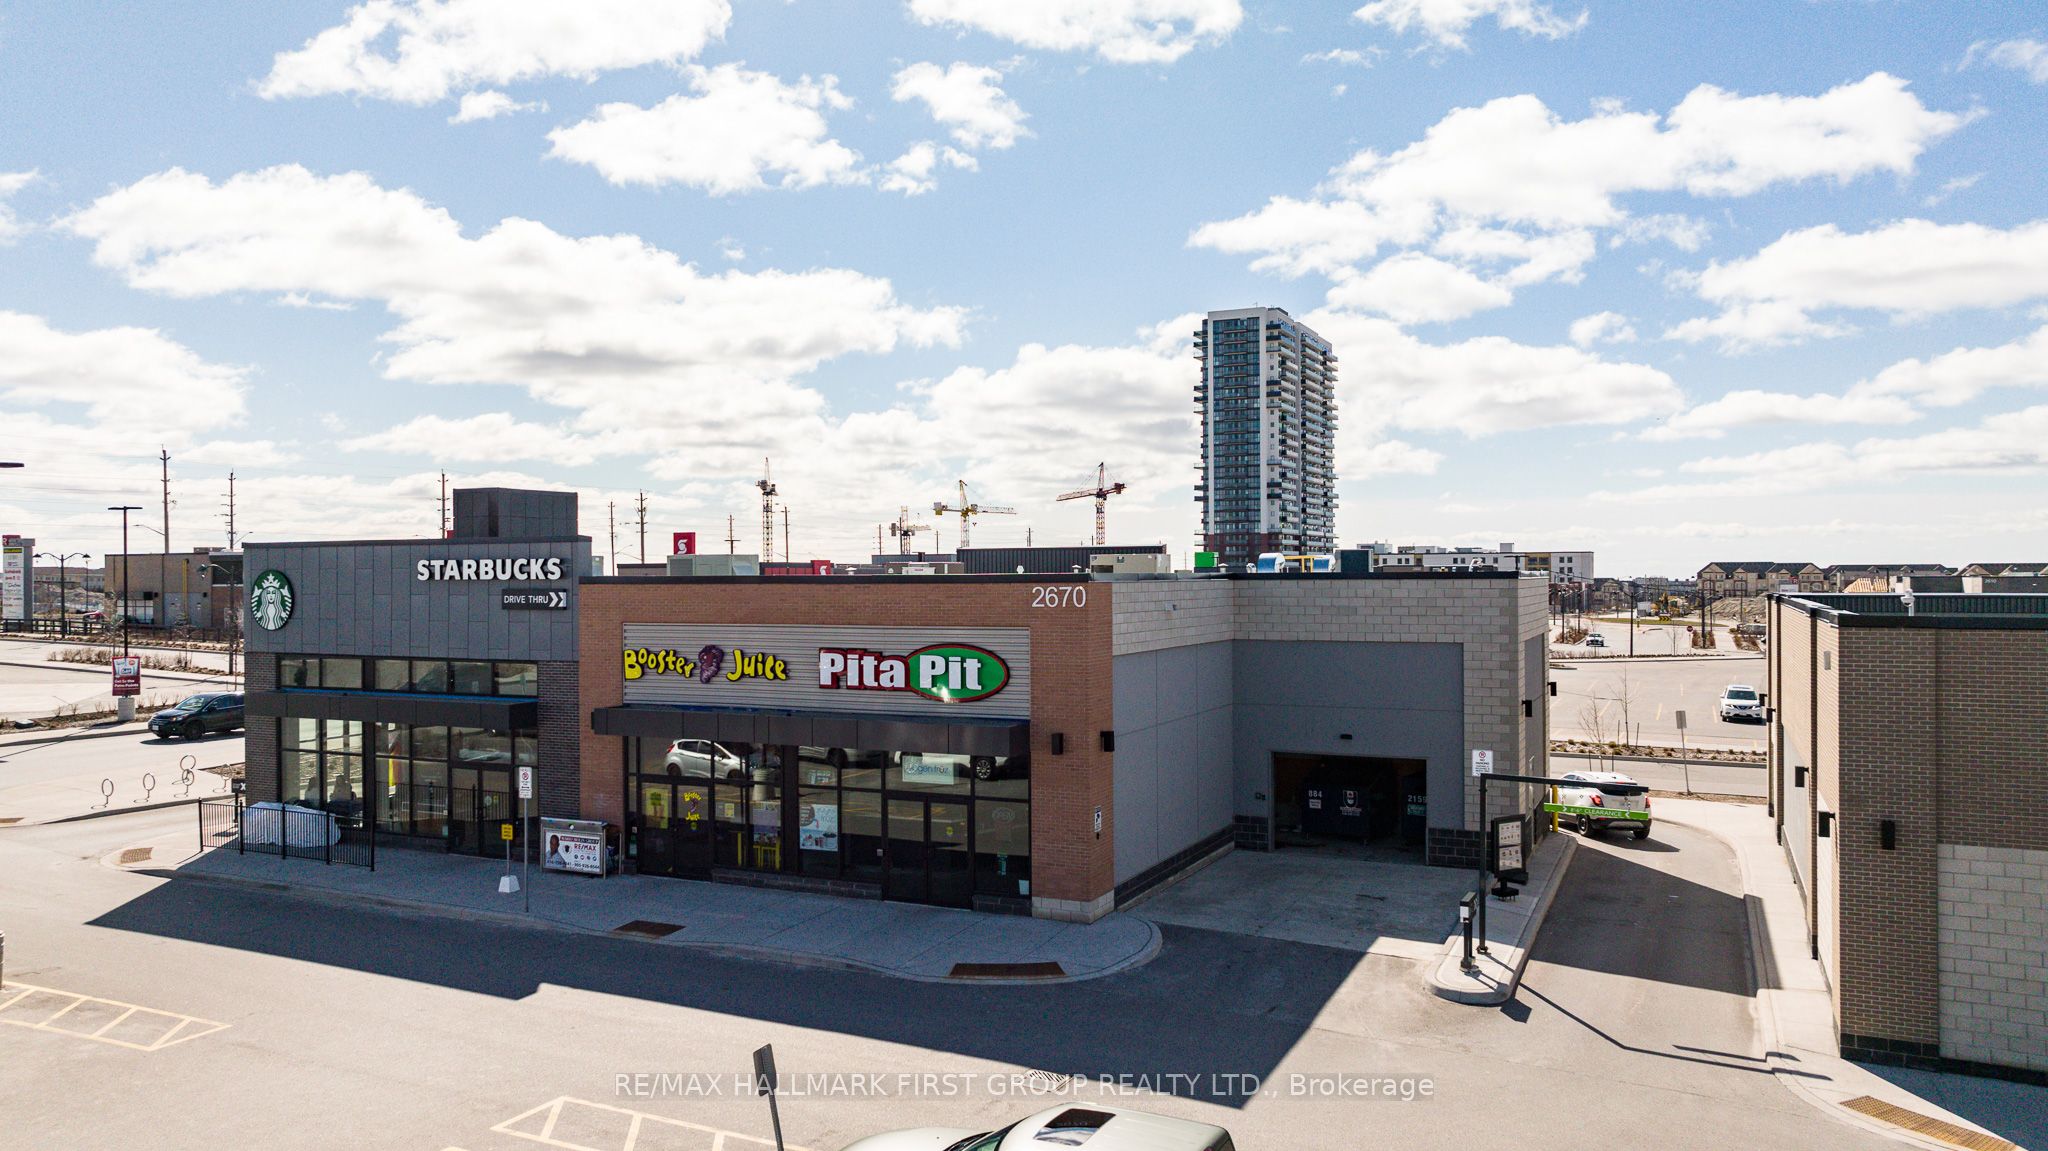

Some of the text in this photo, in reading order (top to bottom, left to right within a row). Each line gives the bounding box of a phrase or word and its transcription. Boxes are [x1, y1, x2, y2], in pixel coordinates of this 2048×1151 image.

[417, 558, 562, 581] STARBUCKS
[503, 595, 549, 604] DRIVE THRU
[1031, 586, 1087, 608] 2670
[624, 648, 788, 681] Booster Juice
[819, 651, 982, 690] Pita Pit
[1584, 808, 1622, 817] CLEARANCE
[574, 843, 597, 851] RE/MAX
